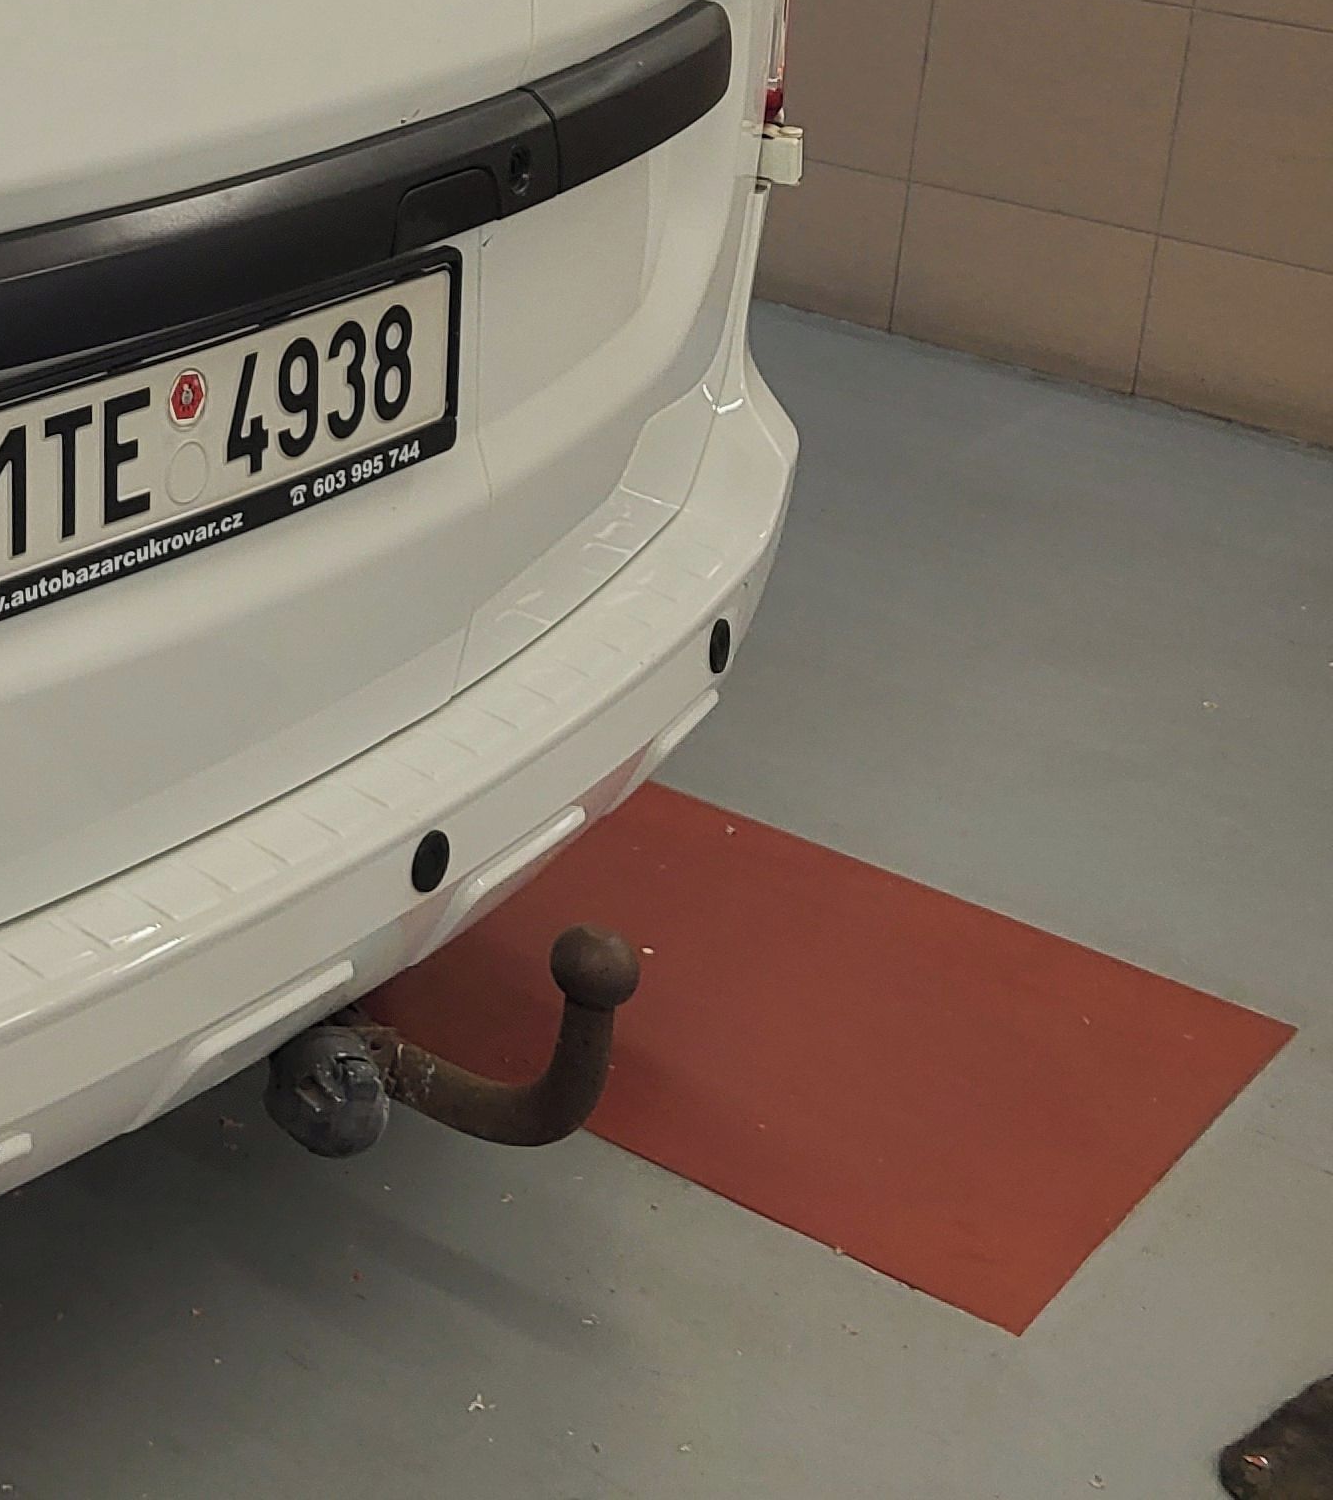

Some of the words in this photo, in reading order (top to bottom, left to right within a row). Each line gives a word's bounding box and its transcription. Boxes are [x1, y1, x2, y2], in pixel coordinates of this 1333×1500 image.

[226, 303, 413, 475] 4938
[312, 468, 347, 498] 603
[350, 454, 384, 483] 995
[387, 439, 421, 469] 744
